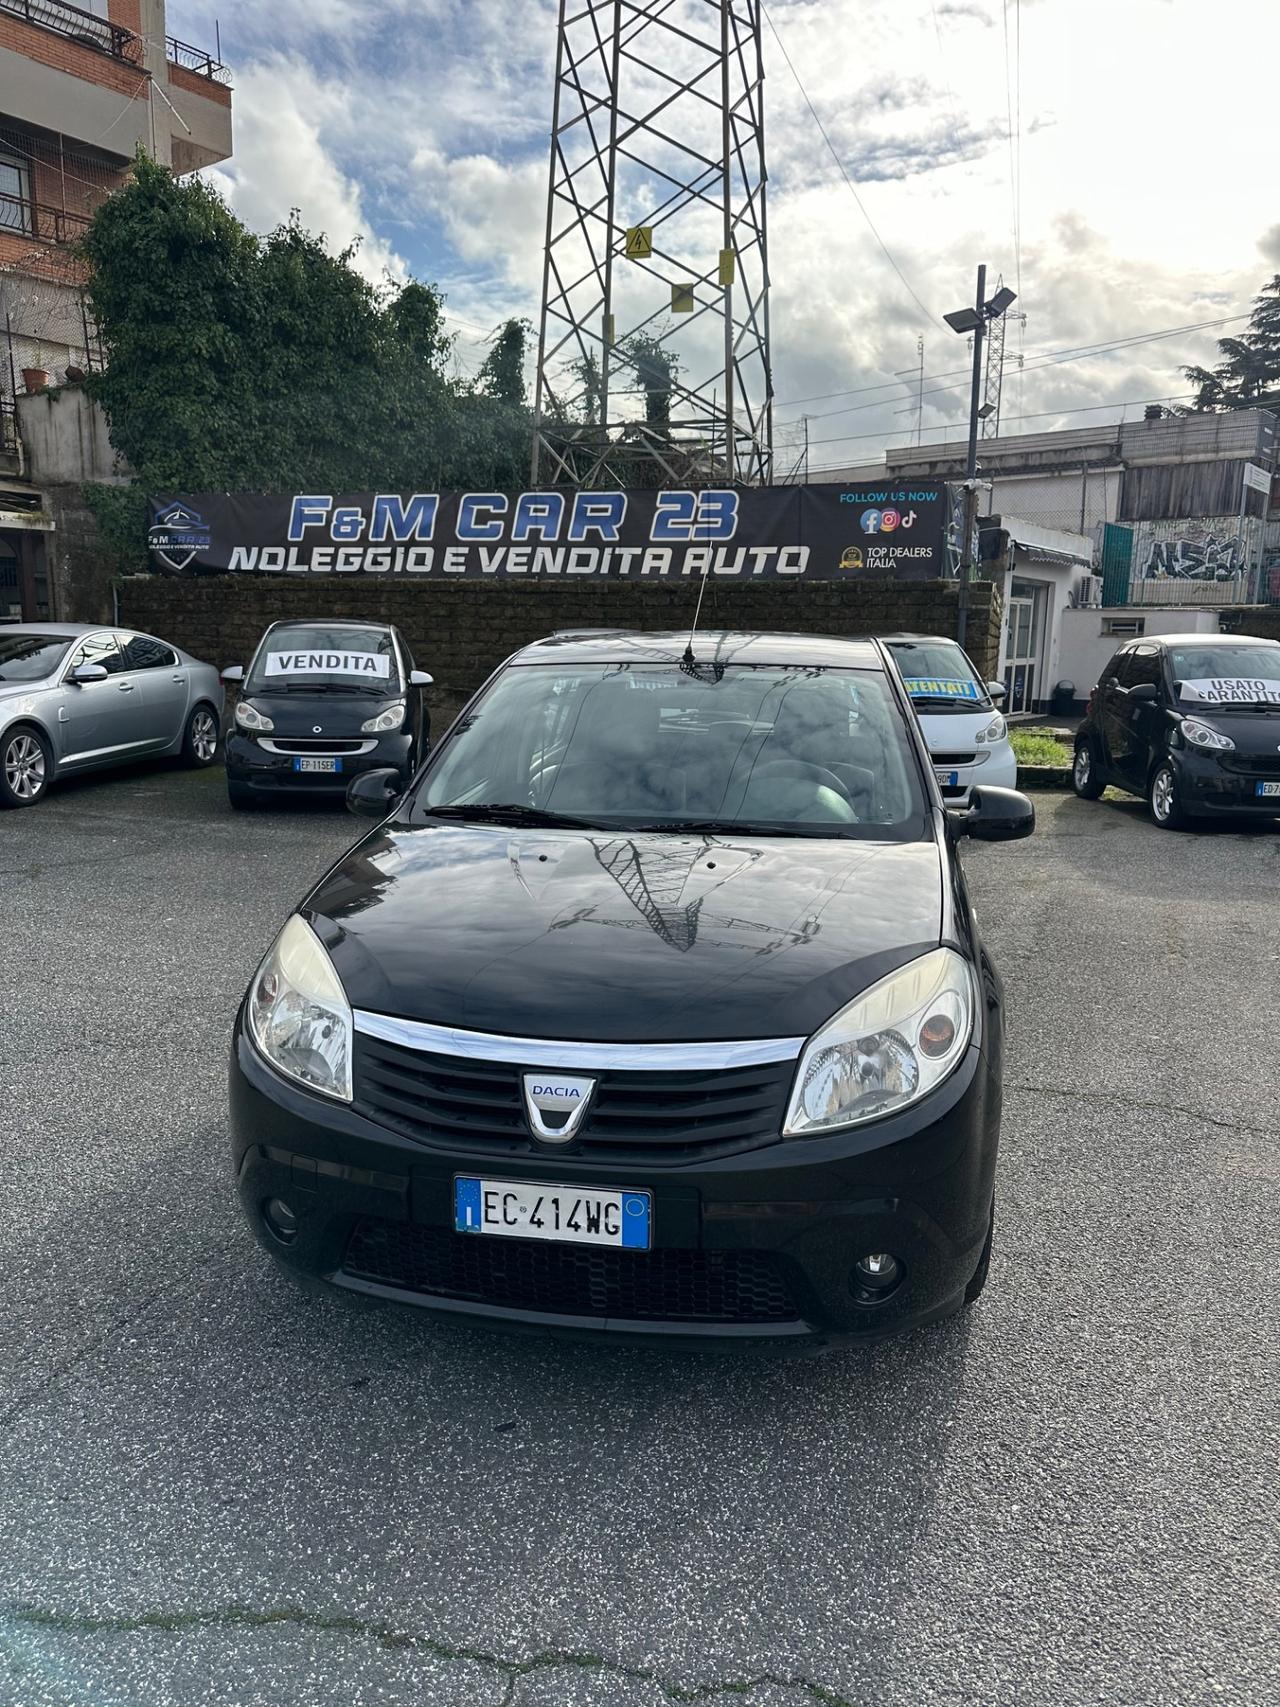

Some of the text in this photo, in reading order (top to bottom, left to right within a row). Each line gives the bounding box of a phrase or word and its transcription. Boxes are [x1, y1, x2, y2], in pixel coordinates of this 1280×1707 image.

[840, 491, 938, 503] FOLLOW US NOW
[287, 489, 739, 542] F&M CAR 23
[867, 547, 933, 558] TOP DEALERS
[227, 546, 811, 575] NOLEGGIO E VENDITA AUTO
[866, 558, 897, 568] ITALIA
[278, 655, 377, 672] VENDITA
[1211, 680, 1266, 691] USATO
[1199, 690, 1280, 702] ARANTIT
[532, 1085, 580, 1098] DACIA
